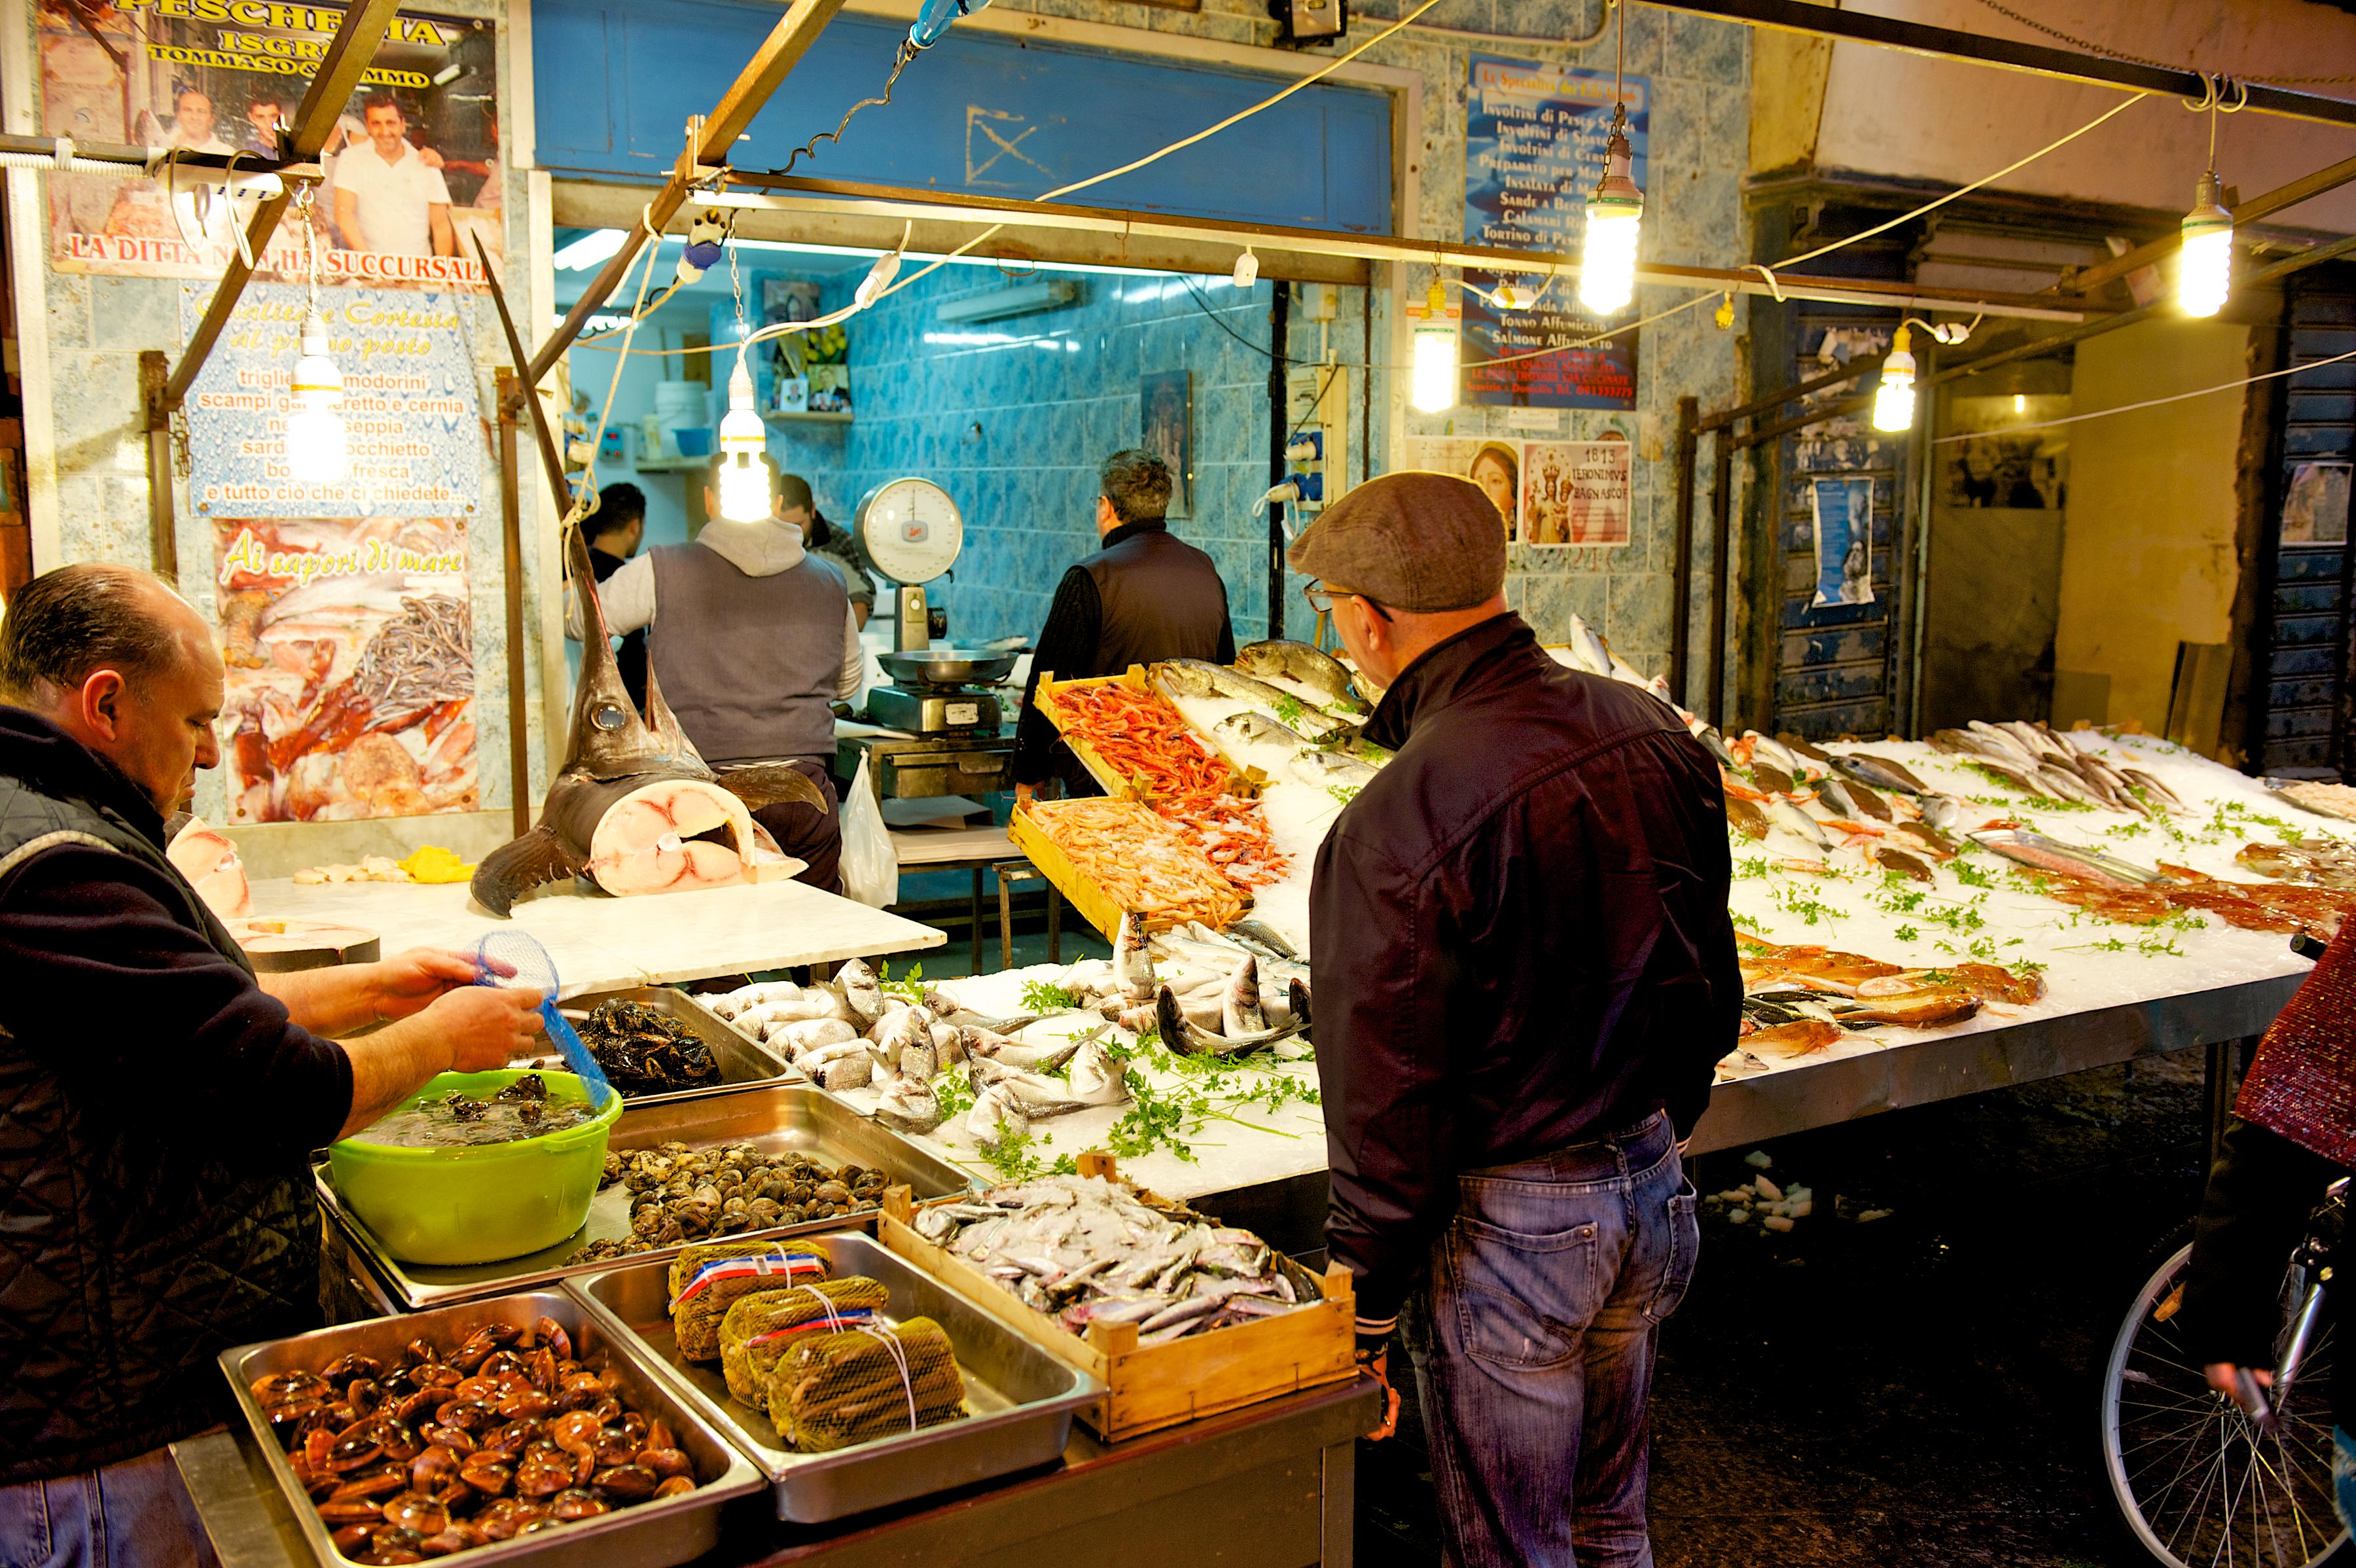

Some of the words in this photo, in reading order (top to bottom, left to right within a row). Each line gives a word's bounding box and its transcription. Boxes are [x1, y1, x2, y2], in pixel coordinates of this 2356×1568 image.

[113, 0, 448, 46] ESCHEIA
[220, 31, 332, 60] ISGR
[151, 46, 296, 77] TOMMASO
[1541, 107, 1554, 123] di
[1555, 126, 1568, 142] di
[1557, 145, 1571, 160] di
[1560, 180, 1573, 195] di
[71, 236, 107, 260] LA
[116, 238, 202, 264] DITTA
[213, 244, 270, 269] NN
[321, 309, 336, 323] e
[344, 302, 459, 329] Cortesia
[230, 329, 262, 349] al
[361, 338, 430, 361] posto
[200, 393, 272, 412] scampi
[392, 400, 402, 412] e
[408, 398, 463, 413] cernia
[353, 462, 409, 478] fresca
[207, 487, 218, 499] e
[224, 485, 270, 500] tutto
[276, 484, 305, 500] ciò
[312, 484, 344, 500] che
[351, 486, 366, 500] ci
[221, 531, 263, 581] Ai
[271, 548, 357, 584] sapori
[366, 541, 391, 571] di
[399, 550, 462, 572] mare
